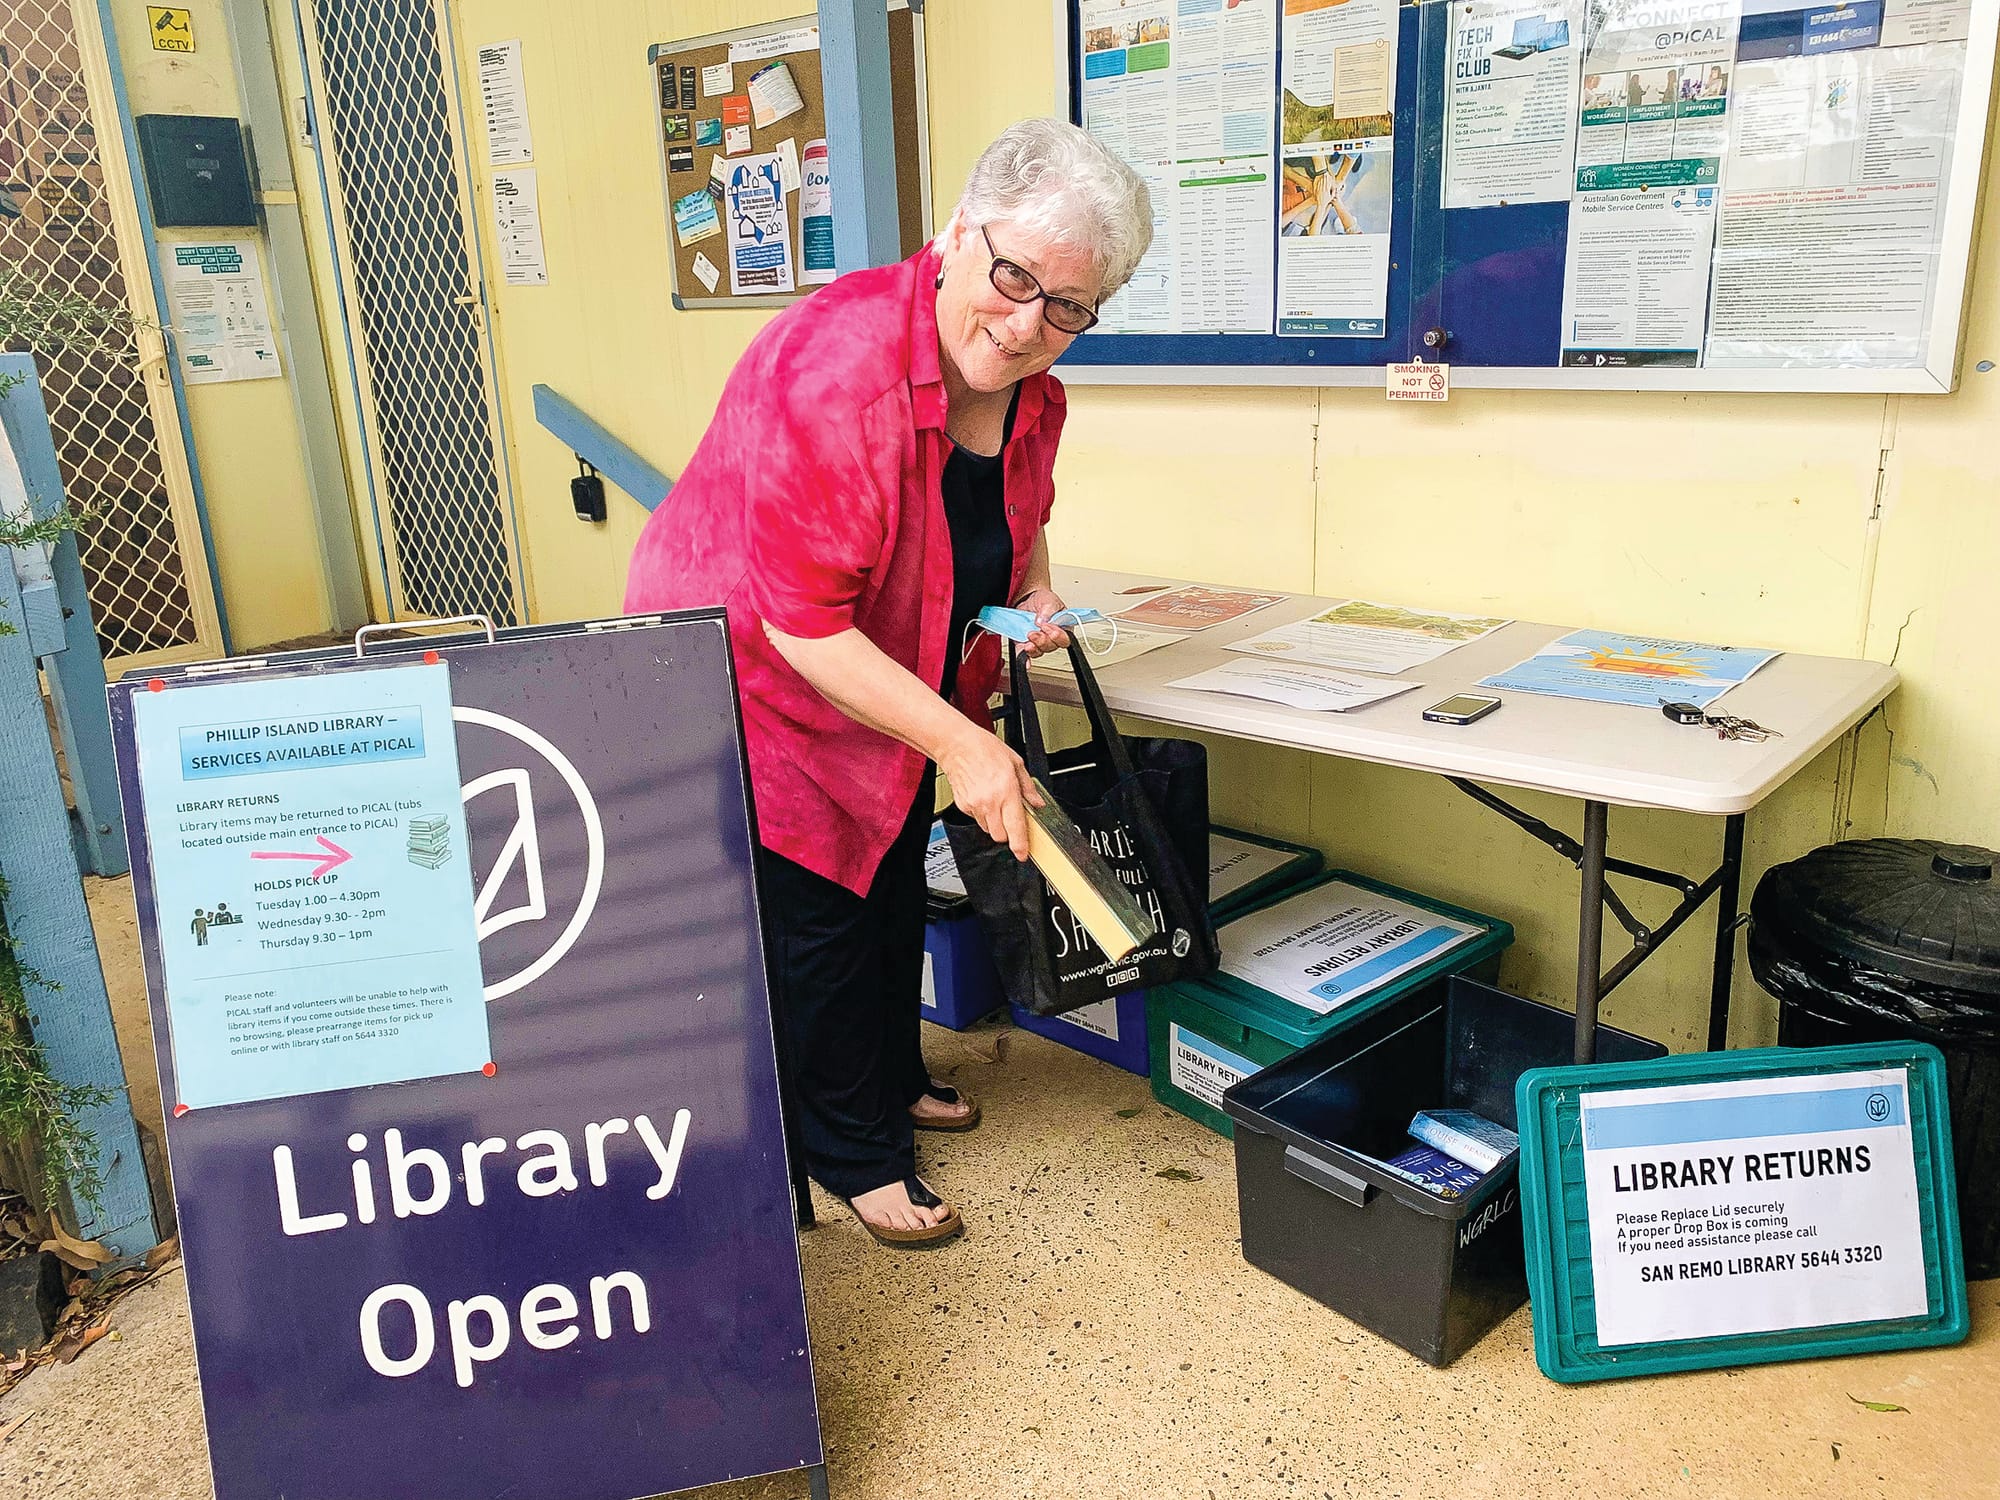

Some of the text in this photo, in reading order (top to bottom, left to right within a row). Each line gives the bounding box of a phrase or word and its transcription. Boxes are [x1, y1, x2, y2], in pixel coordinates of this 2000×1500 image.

[159, 39, 189, 50] CCTV
[1459, 26, 1493, 46] TECH
[1655, 26, 1725, 49] @PICAL
[1457, 46, 1483, 60] FIX IT
[1457, 58, 1491, 78] CLUB
[1587, 112, 1621, 120] WORKSPACE
[1633, 105, 1671, 113] EMPLOYMENT
[1582, 192, 1665, 203] Australian Government
[1607, 204, 1634, 212] Service
[1635, 203, 1665, 211] Centres
[1394, 365, 1440, 373] SMOKING
[1402, 378, 1423, 386] NOT
[1389, 391, 1445, 399] PERMITTED
[207, 715, 384, 743] PHILLIP ISLAND LIBRARY
[192, 737, 415, 769] SERVICES AVAILABLE AT PICAL
[177, 794, 280, 813] LIBRARY RETURNS
[180, 800, 422, 832] Library items may be returned to PICAL (tubs
[182, 817, 398, 848] located outside main entrance to PICAL)
[254, 874, 338, 892] HOLDS PICK UP
[256, 891, 380, 911] Tuesday 1.00 4.30pm
[258, 916, 321, 930] Wednesday
[362, 909, 386, 920] 2pm
[260, 930, 372, 949] Thursday 9.30 1pm
[1366, 919, 1423, 949] LIBRARY
[1304, 945, 1370, 977] RETURNS
[225, 994, 252, 1002] Please
[227, 1008, 251, 1017] PICAL
[253, 1005, 272, 1014] staff
[275, 1003, 290, 1012] and
[292, 999, 337, 1009] volunteers
[339, 995, 354, 1004] will
[356, 994, 366, 1002] be
[368, 991, 397, 1000] unable
[410, 987, 428, 995] help
[430, 984, 448, 993] with
[228, 1022, 255, 1030] library
[284, 1015, 289, 1023] if
[291, 1016, 307, 1024] you
[309, 1012, 332, 1020] come
[334, 1007, 365, 1017] outside
[368, 1005, 391, 1013] these
[420, 999, 444, 1007] There
[287, 1027, 314, 1037] please
[316, 1021, 362, 1033] prearrange
[365, 1018, 388, 1026] items
[389, 1015, 401, 1023] for
[404, 1012, 420, 1023] pick
[231, 1047, 258, 1055] online
[271, 1042, 290, 1050] with
[292, 1039, 320, 1048] library
[321, 1035, 340, 1044] staff
[355, 1031, 376, 1040] 5644
[378, 1028, 399, 1037] 3320
[1178, 1047, 1215, 1073] LIBRARY
[1218, 1067, 1244, 1082] RETU
[274, 1109, 692, 1236] Library
[1614, 1145, 1871, 1192] LIBRARY RETURNS
[1460, 1189, 1515, 1249] WGRLC
[1617, 1202, 1784, 1225] Please Replace Lid securely
[1617, 1216, 1788, 1240] A proper Drop Box is coming
[1619, 1226, 1817, 1255] If you need assistance please call
[1642, 1245, 1882, 1282] SAN REMO LIBRARY 5644 3320
[360, 1272, 651, 1388] Open
